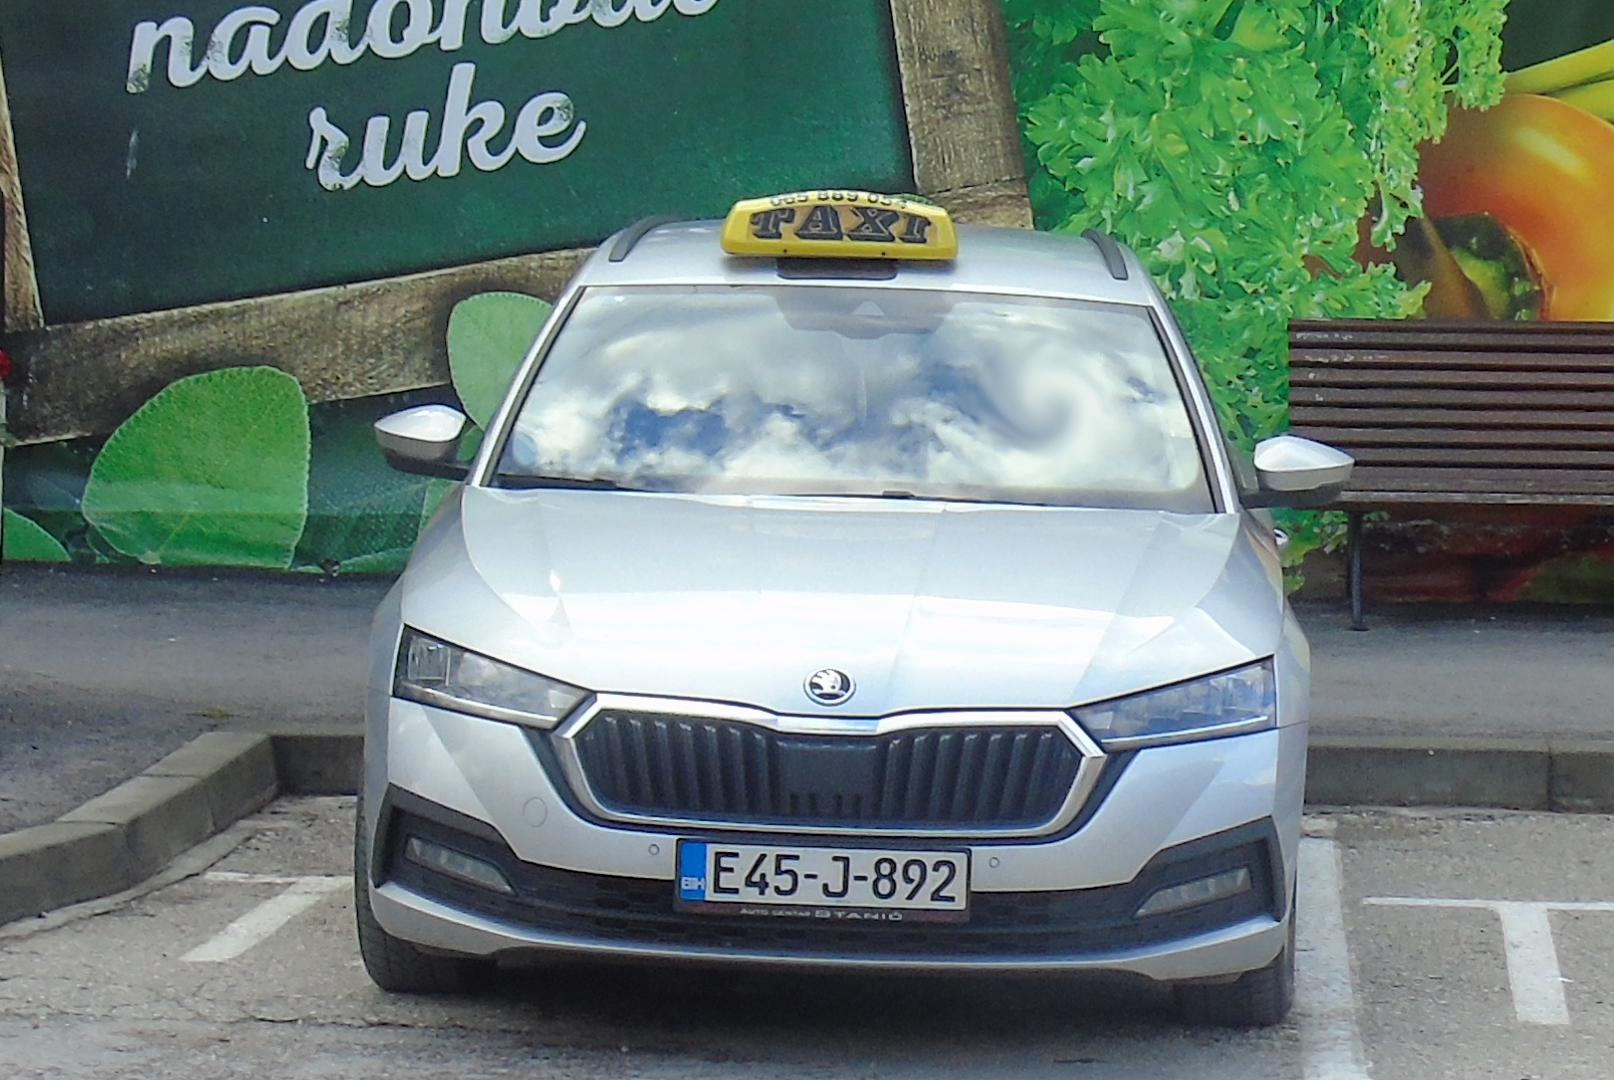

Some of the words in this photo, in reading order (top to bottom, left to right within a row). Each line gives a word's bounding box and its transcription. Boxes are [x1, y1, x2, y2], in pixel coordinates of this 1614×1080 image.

[126, 0, 721, 93] nadohv
[305, 62, 586, 191] ruke
[752, 205, 931, 243] TAXI
[713, 851, 956, 903] E45-J-892
